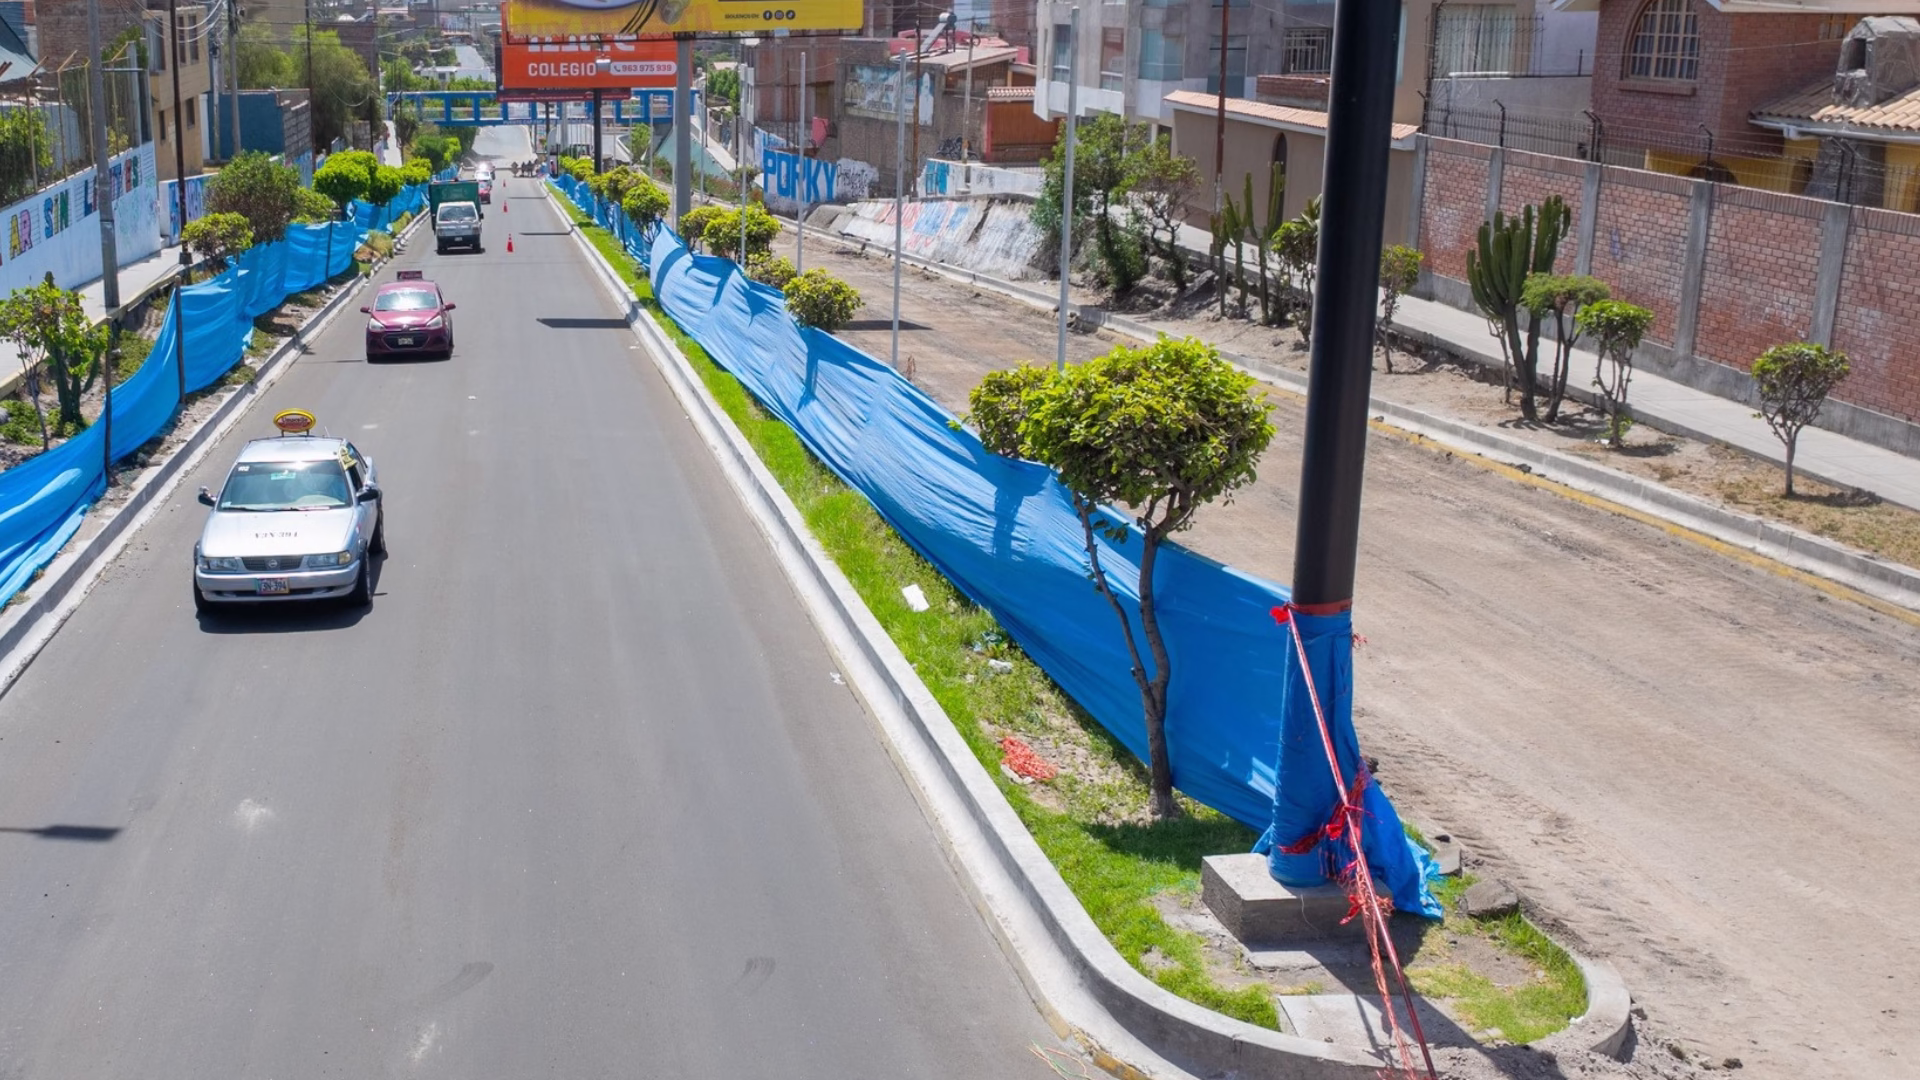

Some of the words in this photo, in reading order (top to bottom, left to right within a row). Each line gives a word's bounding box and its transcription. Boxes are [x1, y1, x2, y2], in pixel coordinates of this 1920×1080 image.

[528, 62, 596, 77] COLEGIO
[621, 64, 637, 72] 963
[639, 64, 655, 72] 975
[763, 149, 837, 203] PORKY
